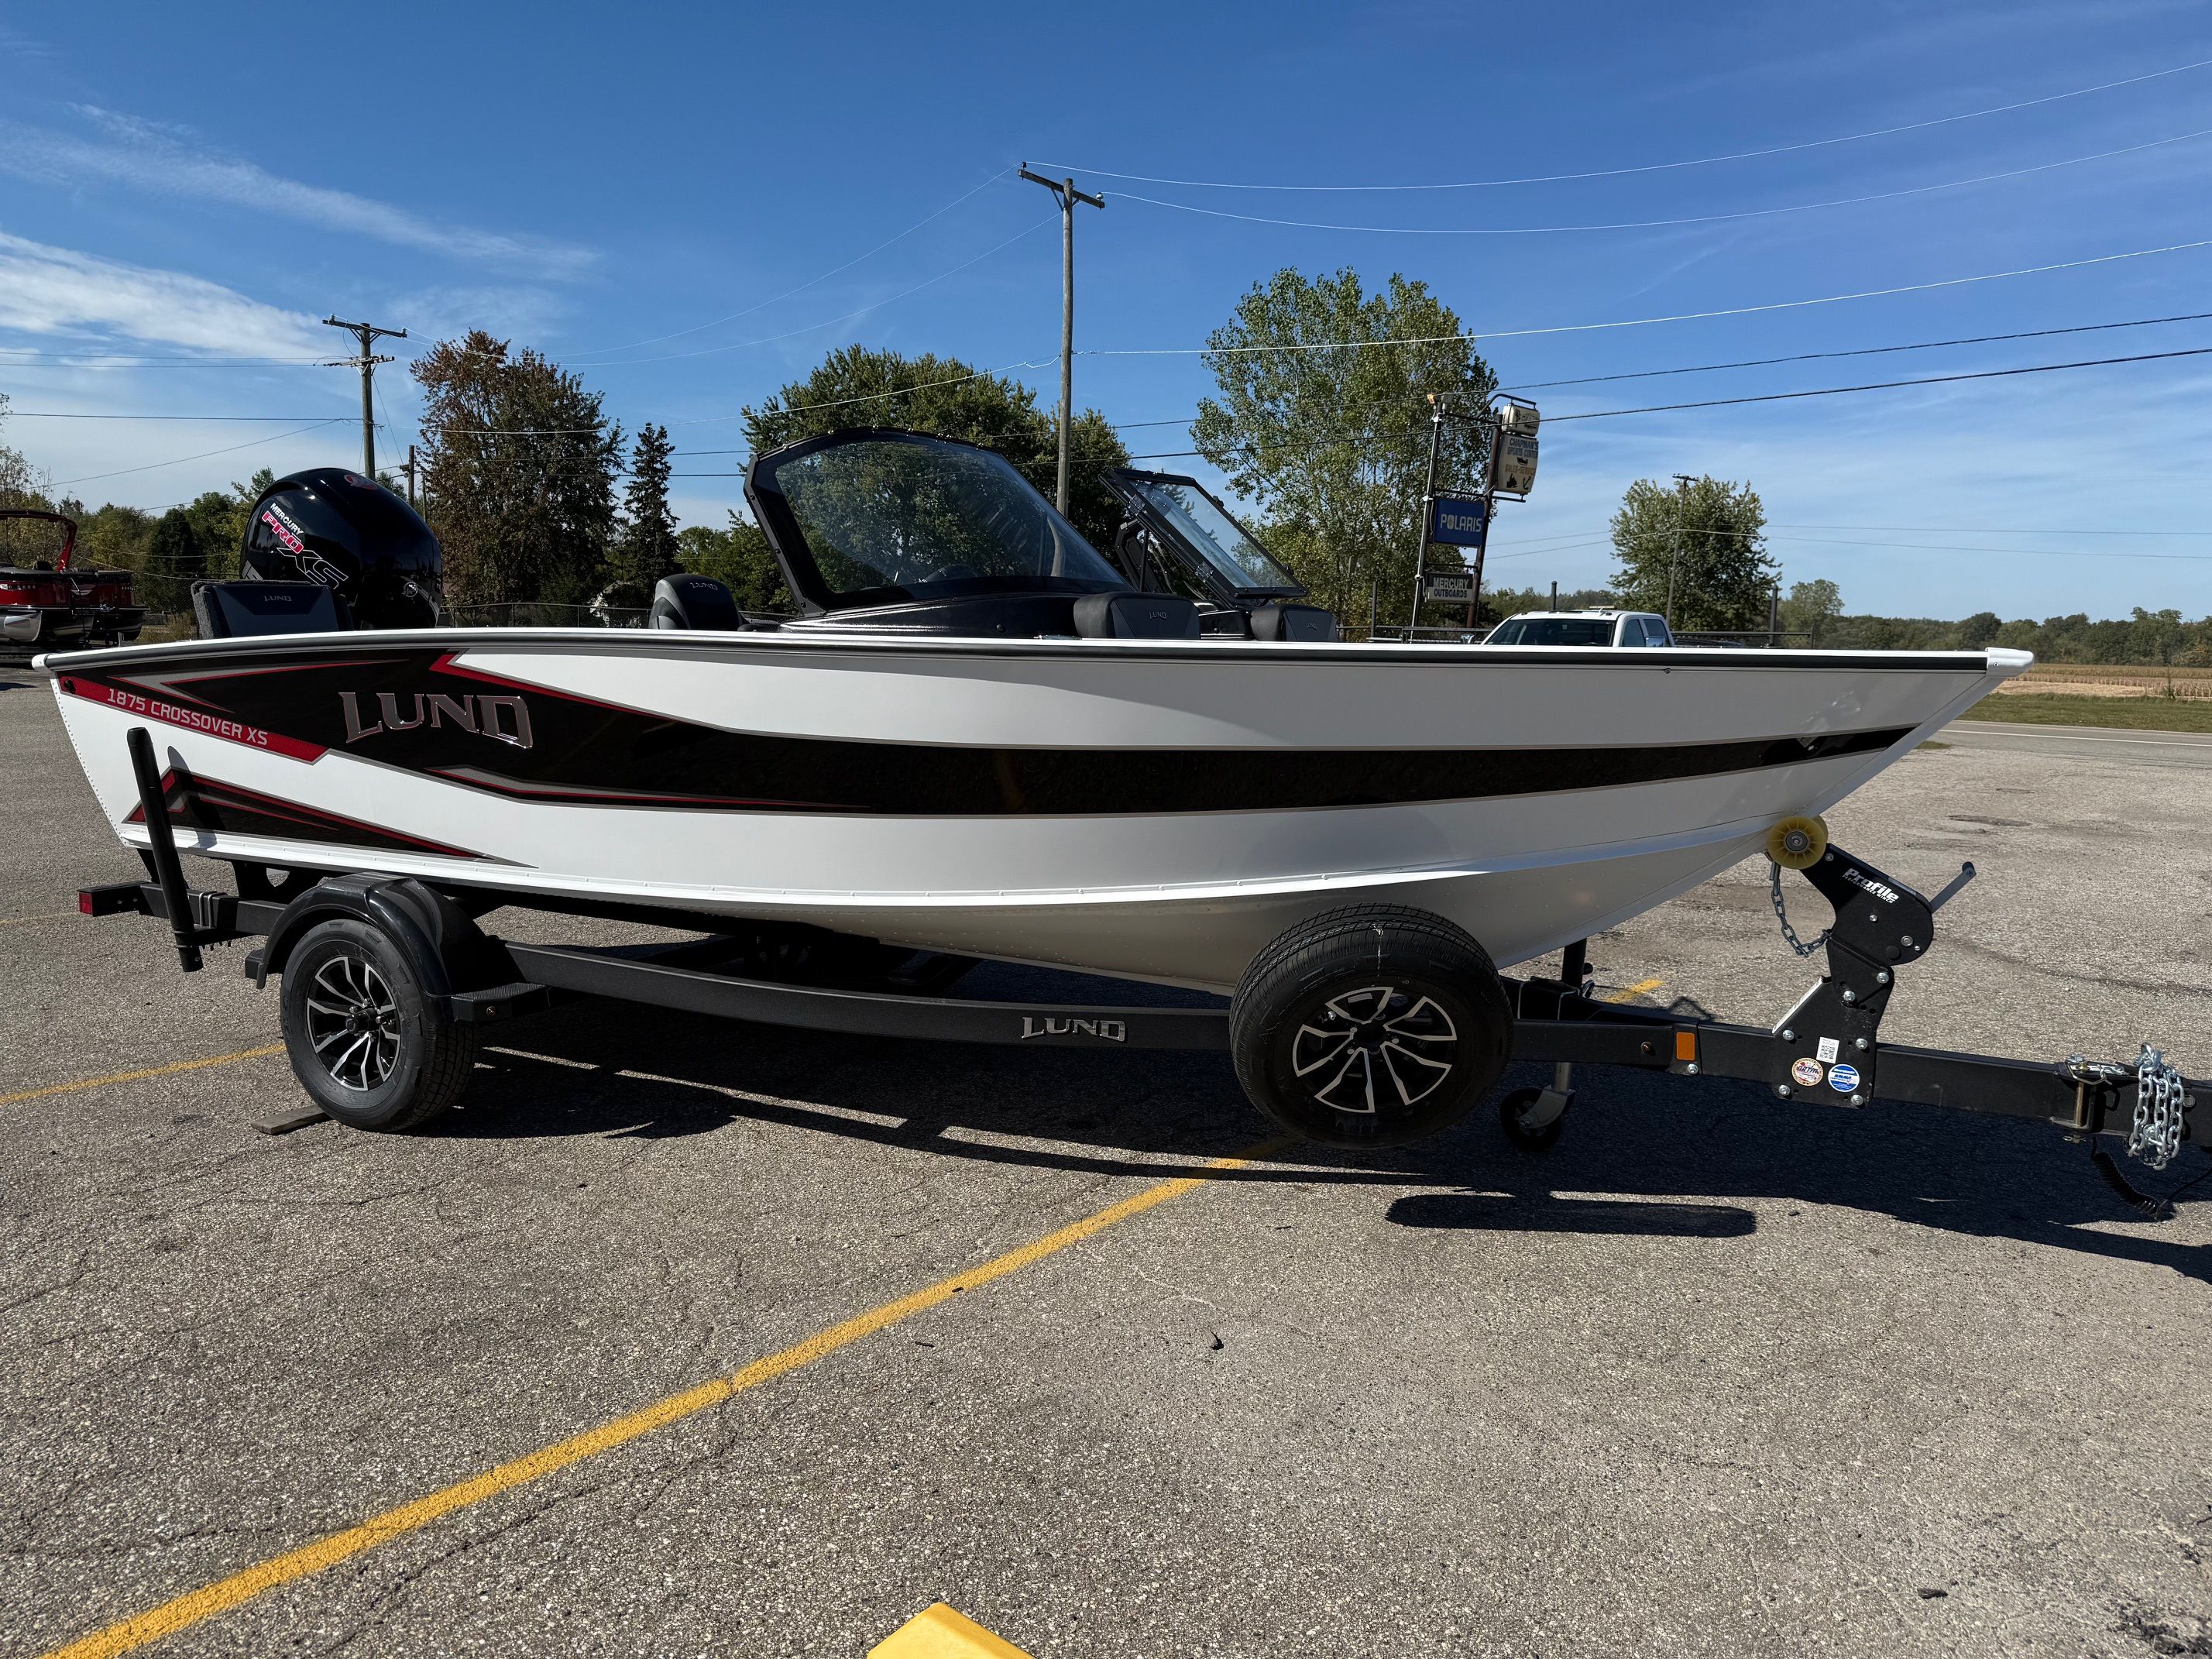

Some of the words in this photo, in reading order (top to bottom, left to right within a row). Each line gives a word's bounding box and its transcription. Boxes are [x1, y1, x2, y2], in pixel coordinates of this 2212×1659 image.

[262, 510, 304, 554] PRO
[270, 503, 304, 536] MERCURY
[1441, 514, 1482, 533] POLARIS
[276, 547, 349, 589] XS
[1433, 577, 1469, 589] MERCURY
[1434, 588, 1468, 598] OUTBOARDS
[107, 689, 146, 712] 1875
[150, 701, 242, 739] CROSSOVER
[246, 726, 268, 746] XS
[338, 692, 534, 749] LUND
[1843, 867, 1899, 901] Profile
[1021, 1016, 1126, 1042] LUND
